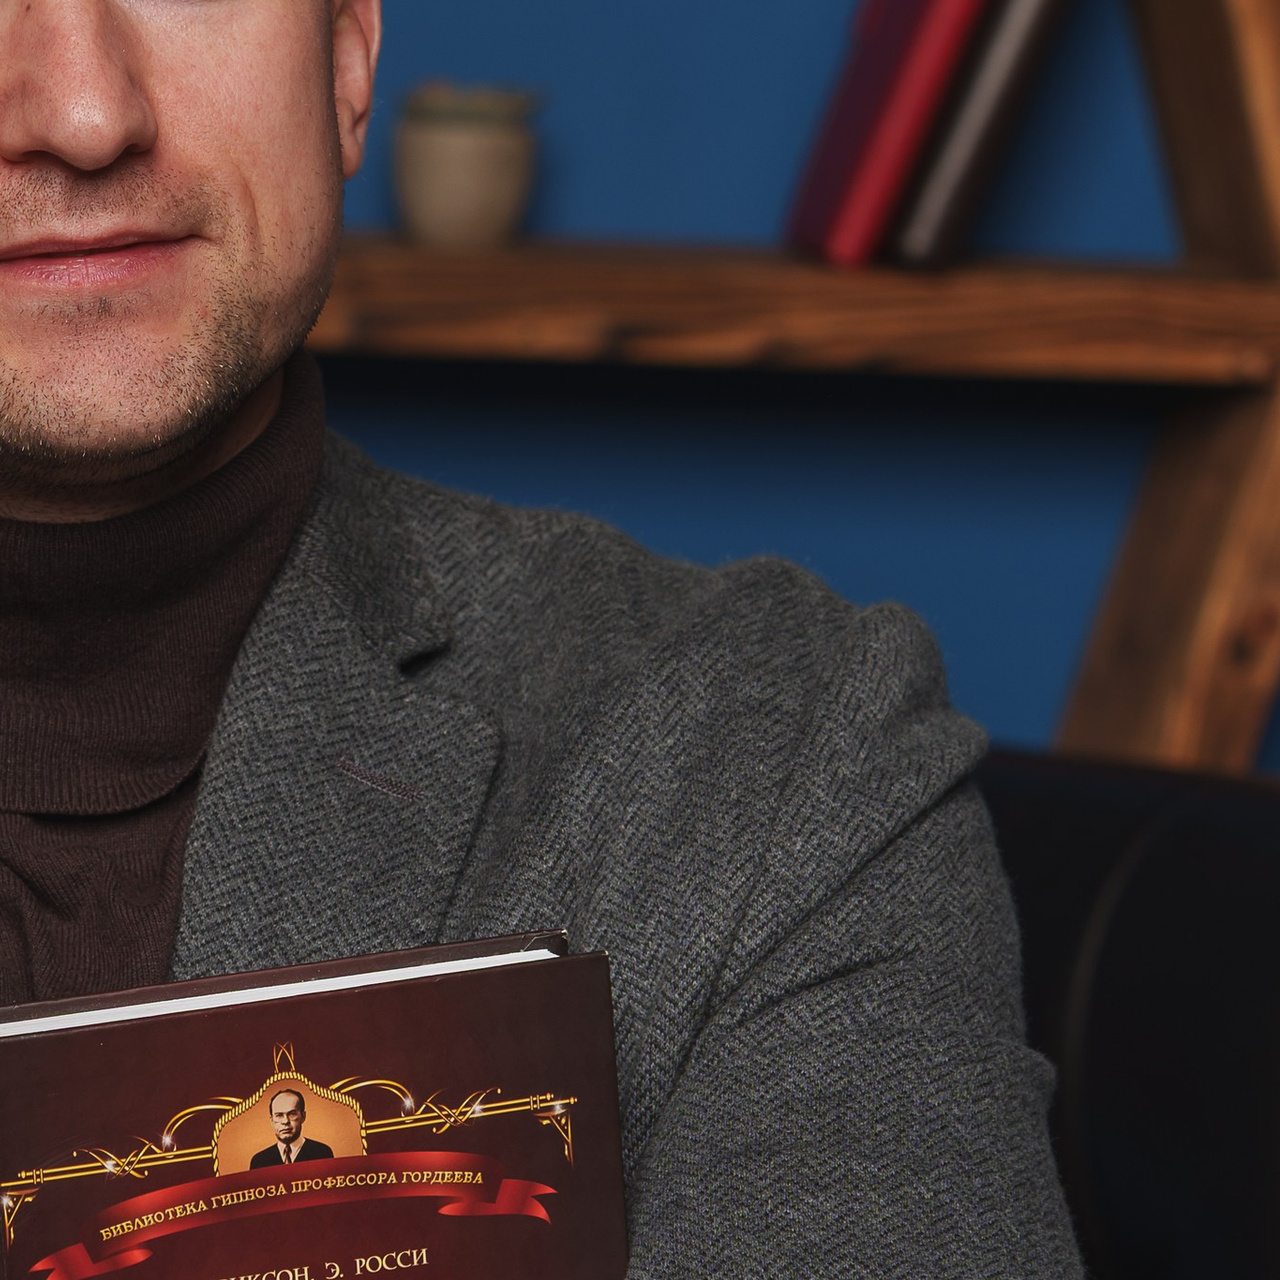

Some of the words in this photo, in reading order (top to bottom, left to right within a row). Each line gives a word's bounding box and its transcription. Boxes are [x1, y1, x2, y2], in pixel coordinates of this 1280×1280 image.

[99, 1200, 208, 1241] БИБЛИОТЕКА
[210, 1183, 287, 1209] ГИПНОЗА
[291, 1172, 398, 1194] ПРОФЕССОРА
[401, 1171, 483, 1185] ГОРДЕЕВА
[325, 1262, 344, 1280] Э.
[355, 1247, 428, 1275] РОССИ
